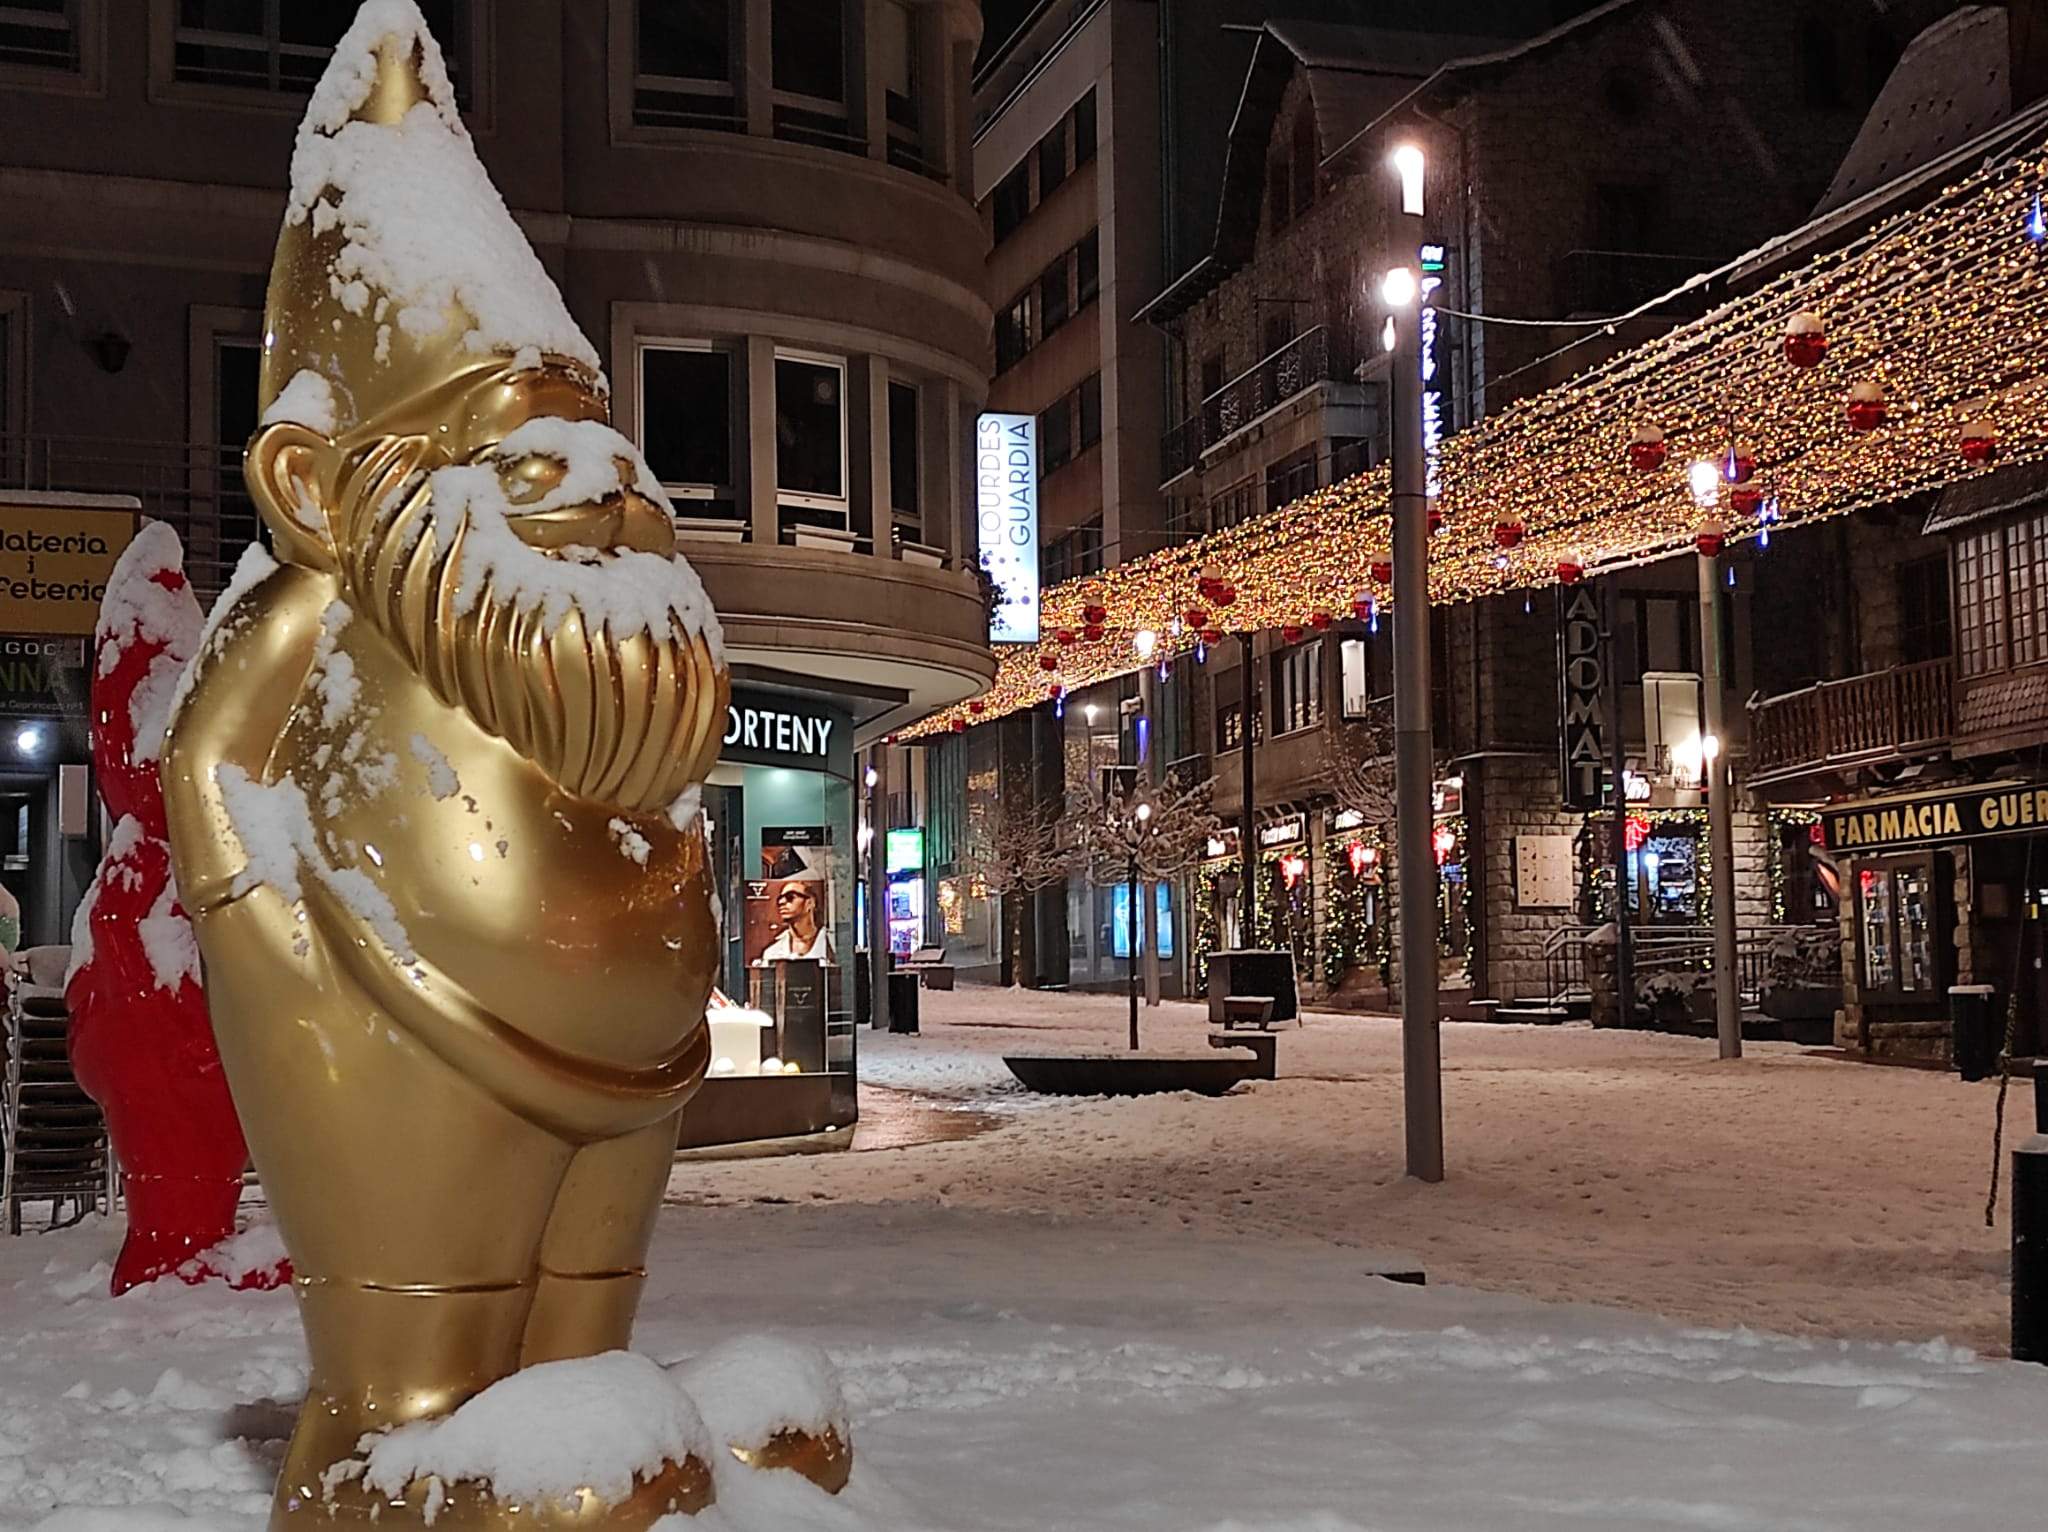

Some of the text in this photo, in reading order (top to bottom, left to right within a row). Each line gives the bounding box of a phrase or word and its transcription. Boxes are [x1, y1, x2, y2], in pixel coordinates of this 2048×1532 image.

[979, 420, 1001, 545] LOURDES
[1008, 421, 1031, 546] GUARDIA
[27, 555, 35, 574] i
[1567, 588, 1601, 795] ADOMAT
